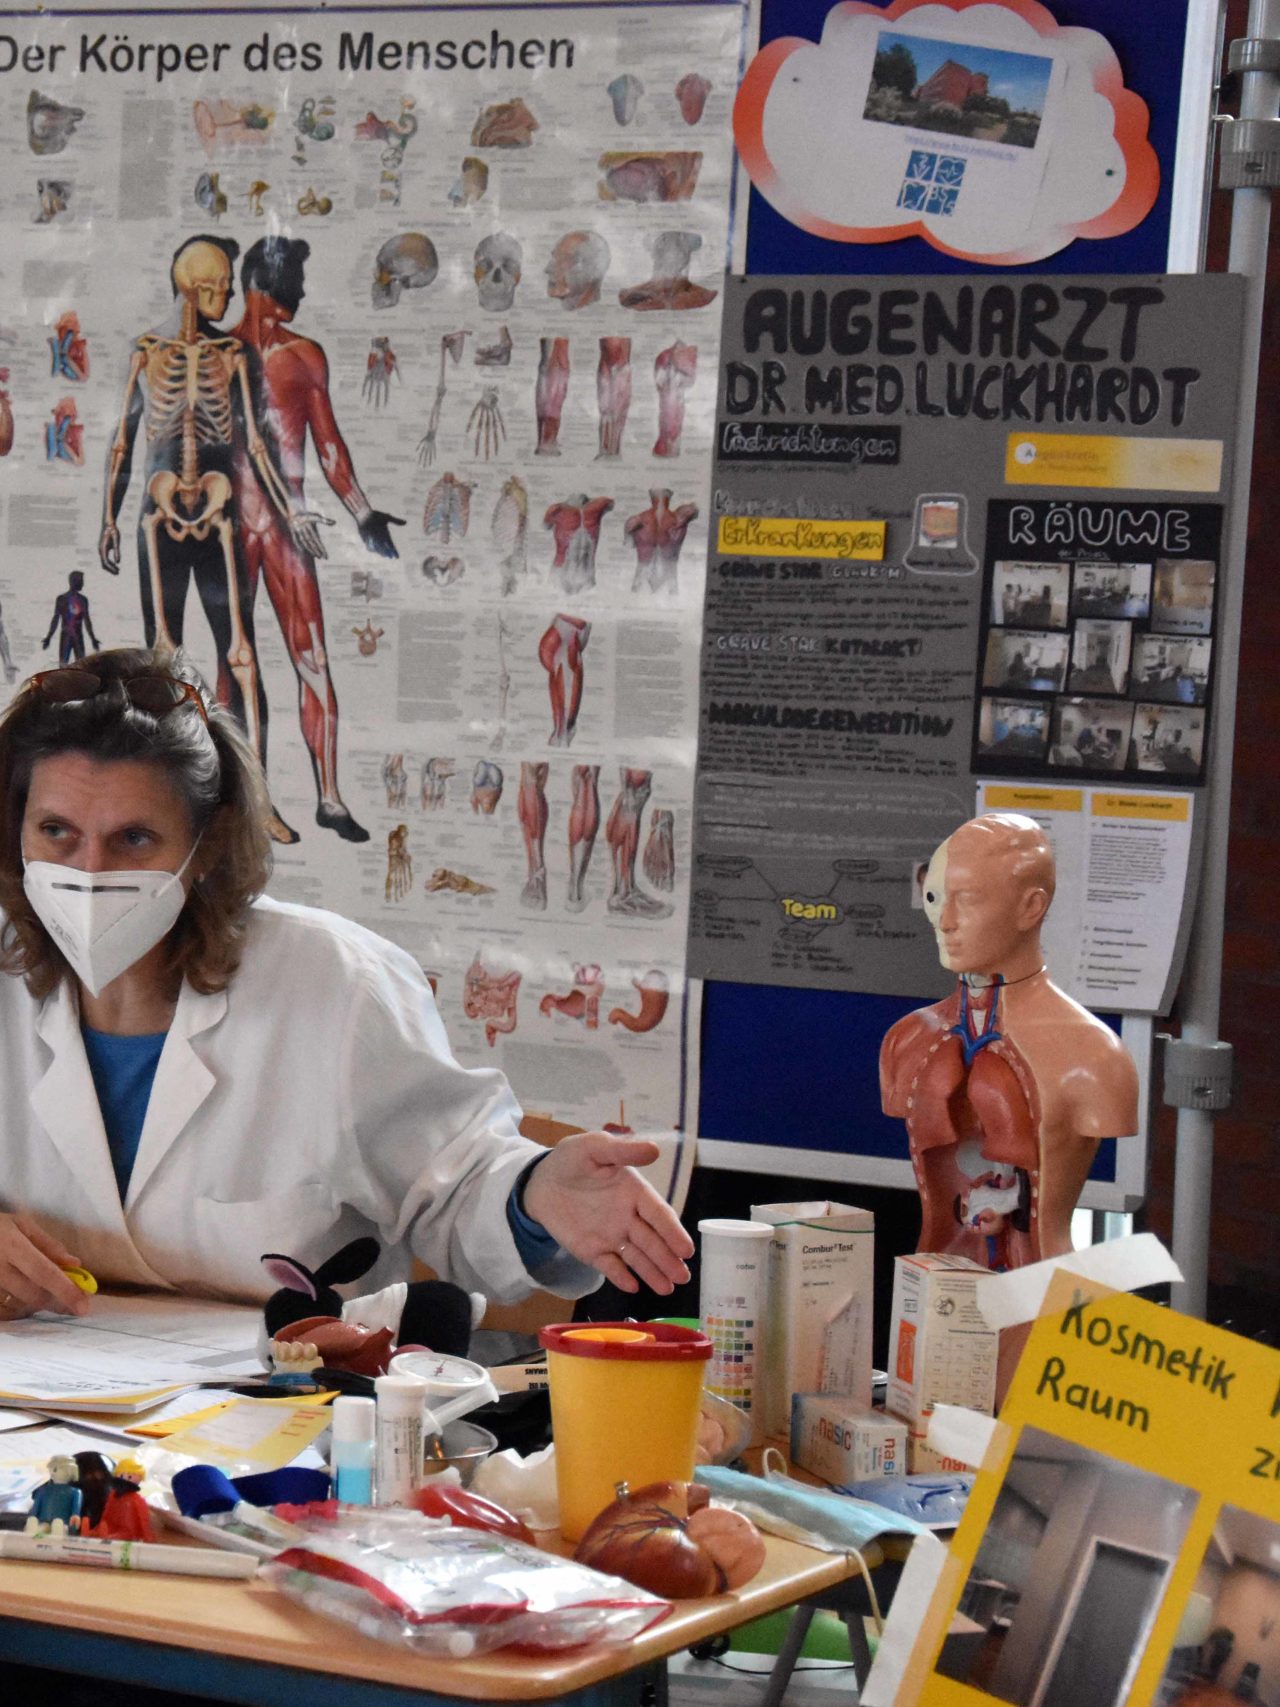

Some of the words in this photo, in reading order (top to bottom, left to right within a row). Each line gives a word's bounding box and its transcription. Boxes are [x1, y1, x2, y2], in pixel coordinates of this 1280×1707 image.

[79, 33, 231, 82] Körper
[243, 32, 322, 73] des
[338, 29, 575, 73] Menschen
[743, 283, 1166, 363] AUGENARZT
[1009, 502, 1191, 552] RÄUME
[782, 898, 837, 921] Team
[1060, 1288, 1237, 1400] Kosmetik
[1035, 1356, 1151, 1432] Raum
[883, 1438, 896, 1475] nasi
